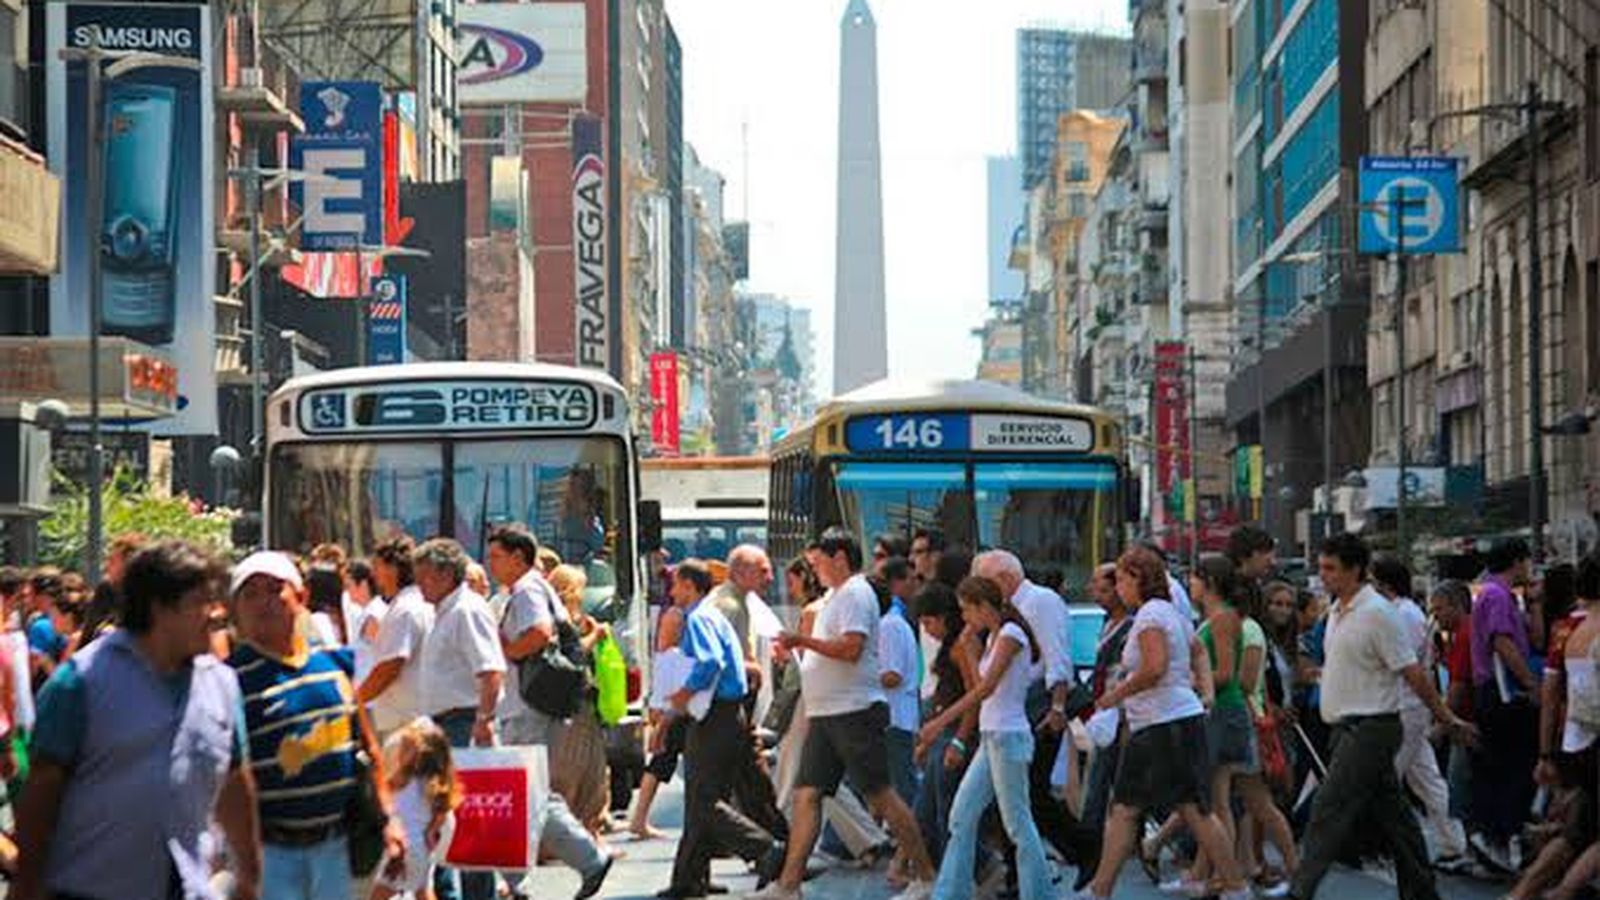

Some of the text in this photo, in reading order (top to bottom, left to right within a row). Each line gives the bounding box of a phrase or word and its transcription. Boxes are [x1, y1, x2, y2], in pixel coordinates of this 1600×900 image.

[74, 26, 192, 48] SAMSUNG
[577, 181, 605, 367] FRAVEGA
[452, 388, 588, 404] POMPEYA
[452, 405, 588, 422] RETIRO
[875, 418, 943, 448] 146
[1000, 422, 1063, 433] SERVICIO
[987, 434, 1075, 446] DIFERENCIAL
